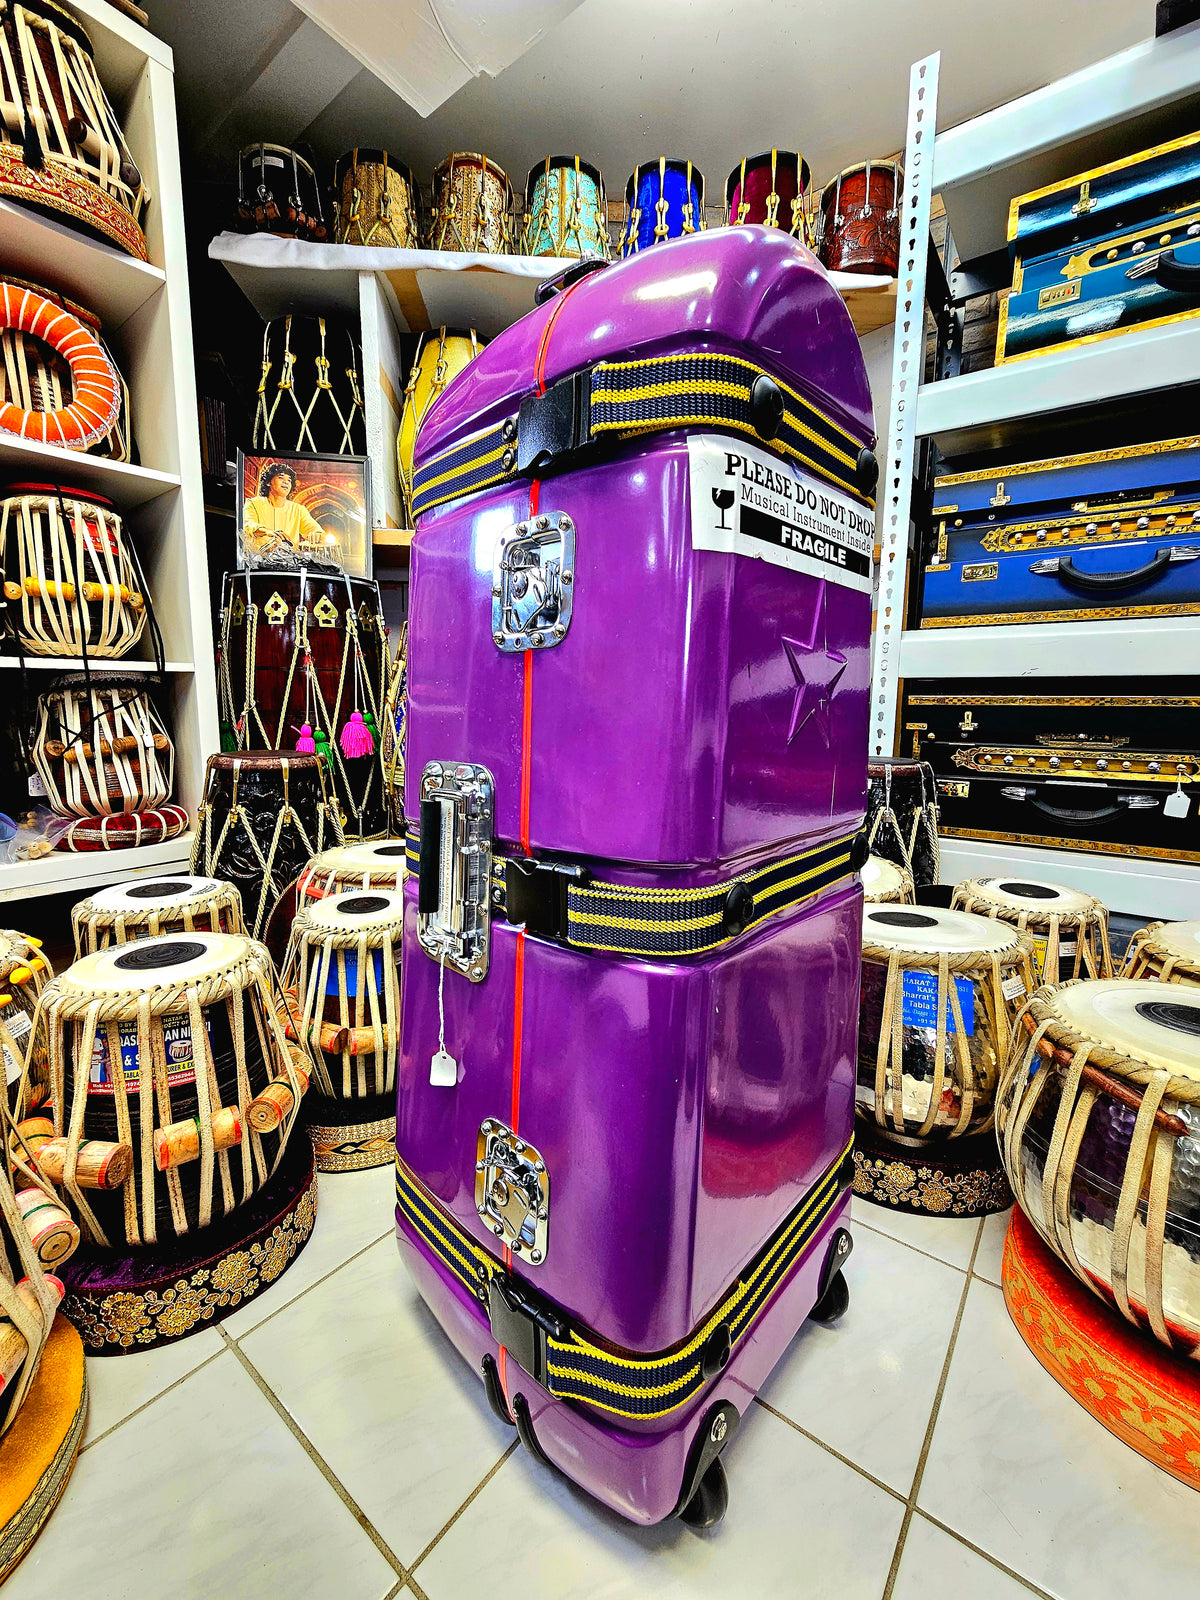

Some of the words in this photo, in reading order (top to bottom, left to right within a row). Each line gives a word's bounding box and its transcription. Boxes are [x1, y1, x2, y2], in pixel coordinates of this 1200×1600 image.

[724, 452, 793, 500] PLEASE
[794, 481, 817, 508] DO
[820, 495, 846, 525] NOT
[848, 510, 876, 540] DROP
[741, 483, 790, 519] Musical
[793, 506, 845, 543] Instrument
[847, 531, 871, 554] Inside
[781, 525, 847, 566] FRAGILE
[903, 977, 931, 987] HARAT
[909, 1000, 930, 1010] Tabla
[124, 1054, 133, 1066] &
